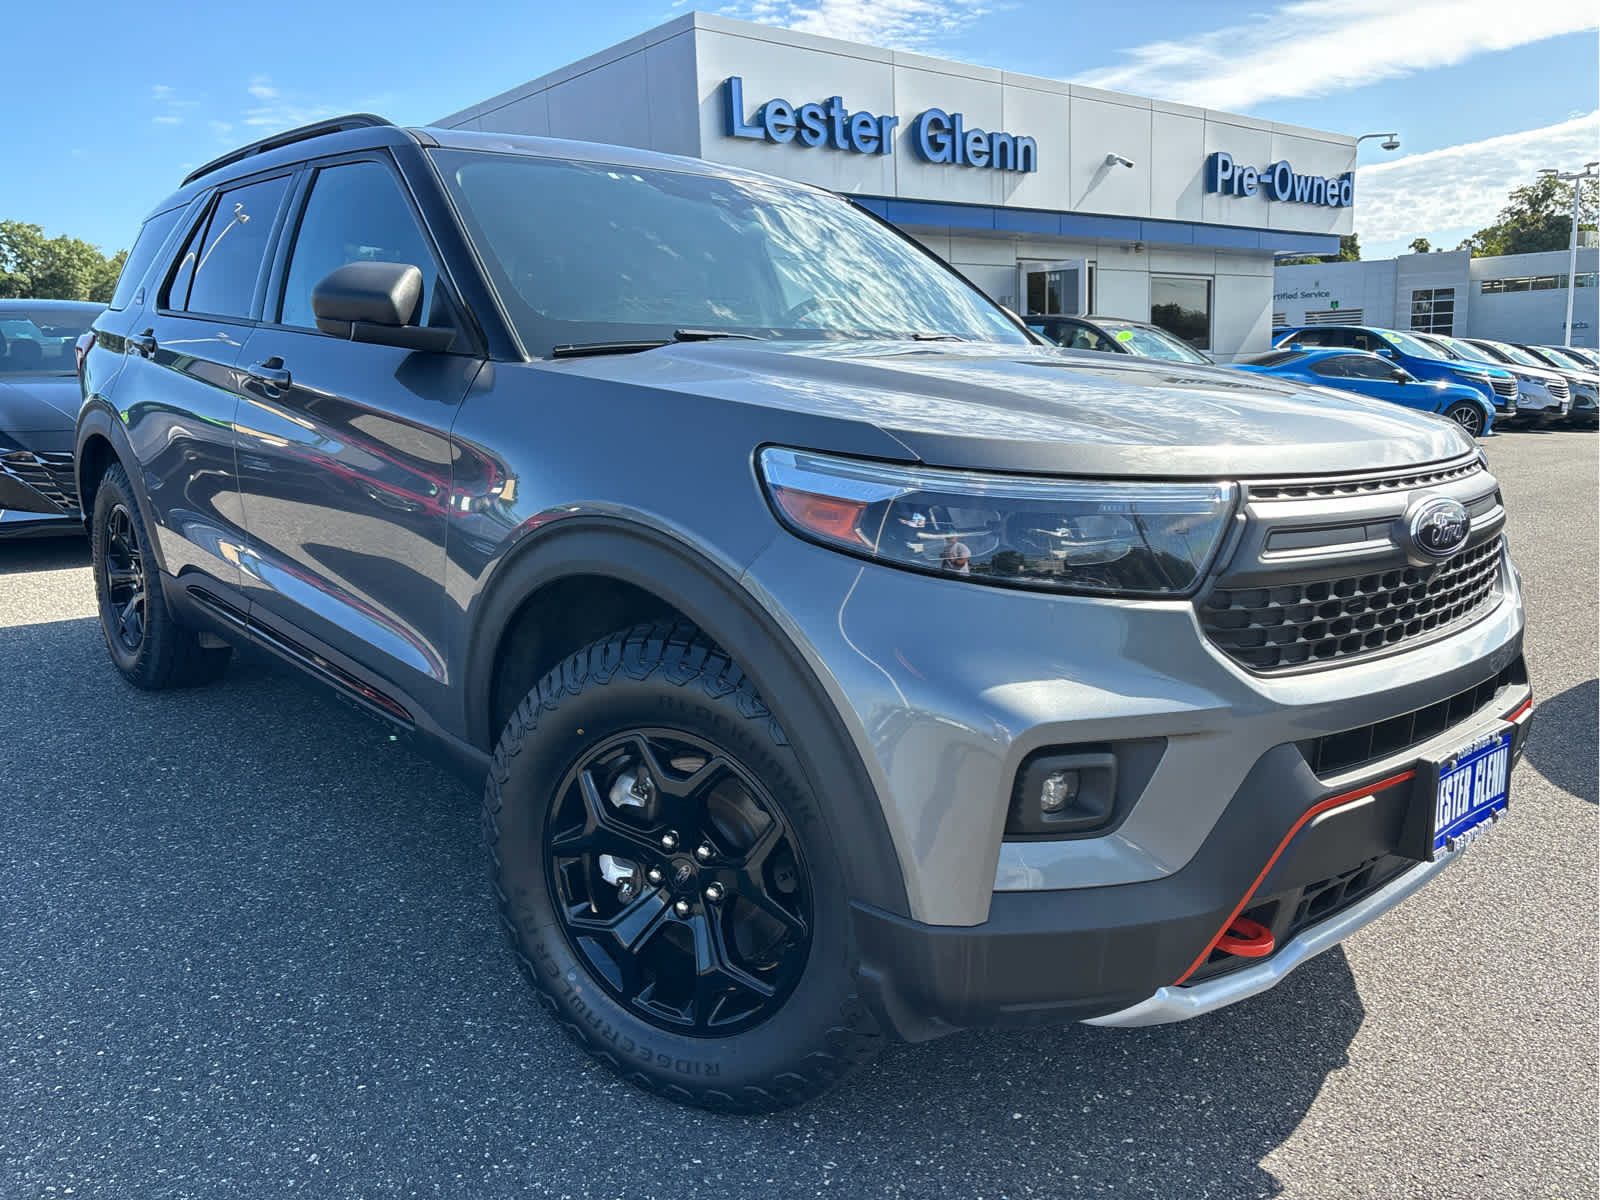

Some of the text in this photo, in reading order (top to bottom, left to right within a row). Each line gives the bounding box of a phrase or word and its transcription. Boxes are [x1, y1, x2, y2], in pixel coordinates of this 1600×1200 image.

[724, 75, 1037, 173] Lester Glenn
[1207, 151, 1354, 208] Pre-Owned
[1273, 287, 1330, 300] rtified Service
[1434, 746, 1509, 833] LESTER GLENN
